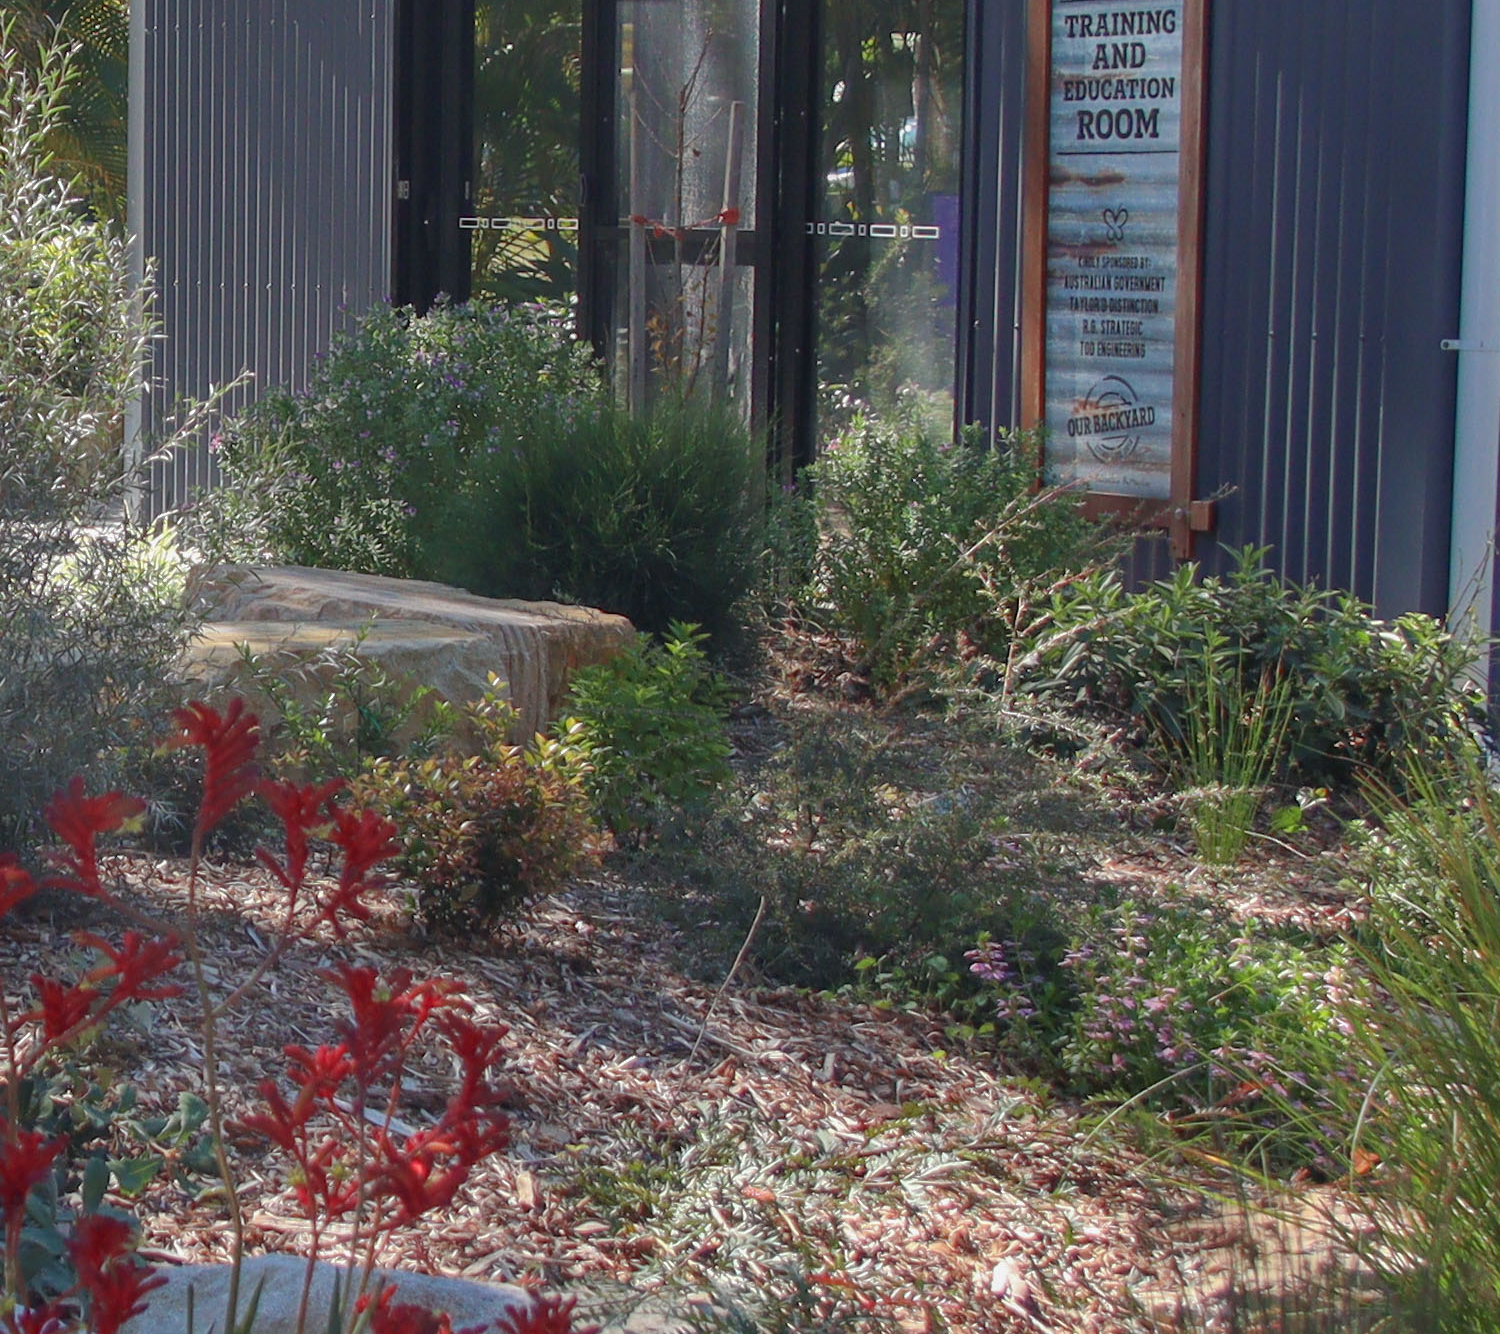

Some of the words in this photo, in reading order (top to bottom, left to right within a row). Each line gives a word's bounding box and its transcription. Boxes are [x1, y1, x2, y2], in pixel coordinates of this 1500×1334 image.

[1065, 9, 1176, 38] TRAINING
[1092, 42, 1146, 70] AND
[1063, 77, 1175, 101] EDUCATION
[1076, 108, 1160, 140] ROOM
[1064, 274, 1112, 290] AUSTRALIAN
[1113, 276, 1165, 291] GOVERNMENT
[1100, 319, 1143, 336] STRATEGIC
[1097, 342, 1146, 358] ENGINEERING
[1067, 418, 1092, 437] OUR
[1093, 407, 1155, 433] BACKYARD
